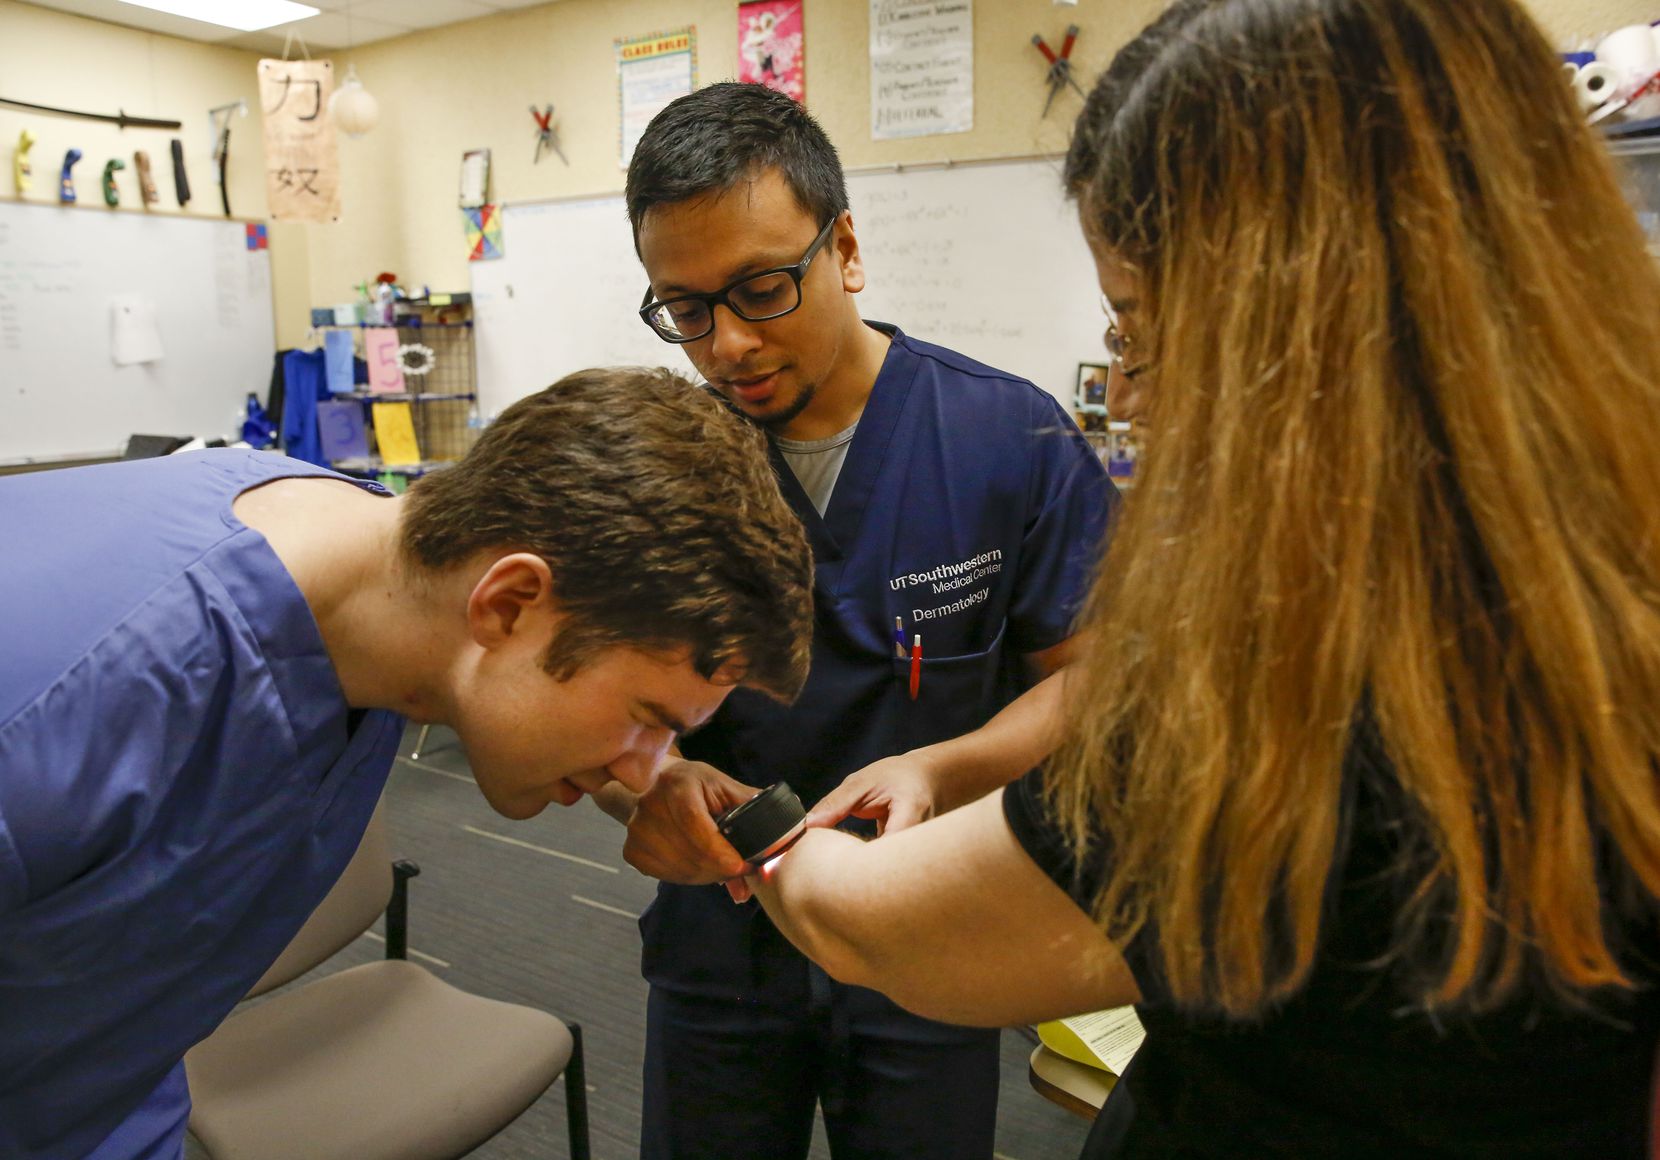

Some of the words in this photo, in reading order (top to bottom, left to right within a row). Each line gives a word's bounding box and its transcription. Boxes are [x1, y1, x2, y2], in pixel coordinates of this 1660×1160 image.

[623, 44, 652, 58] CLASS
[657, 37, 688, 52] RULES
[267, 75, 320, 121] 力
[932, 573, 973, 594] Medical
[973, 563, 1002, 580] Center
[912, 587, 990, 622] Dermatology
